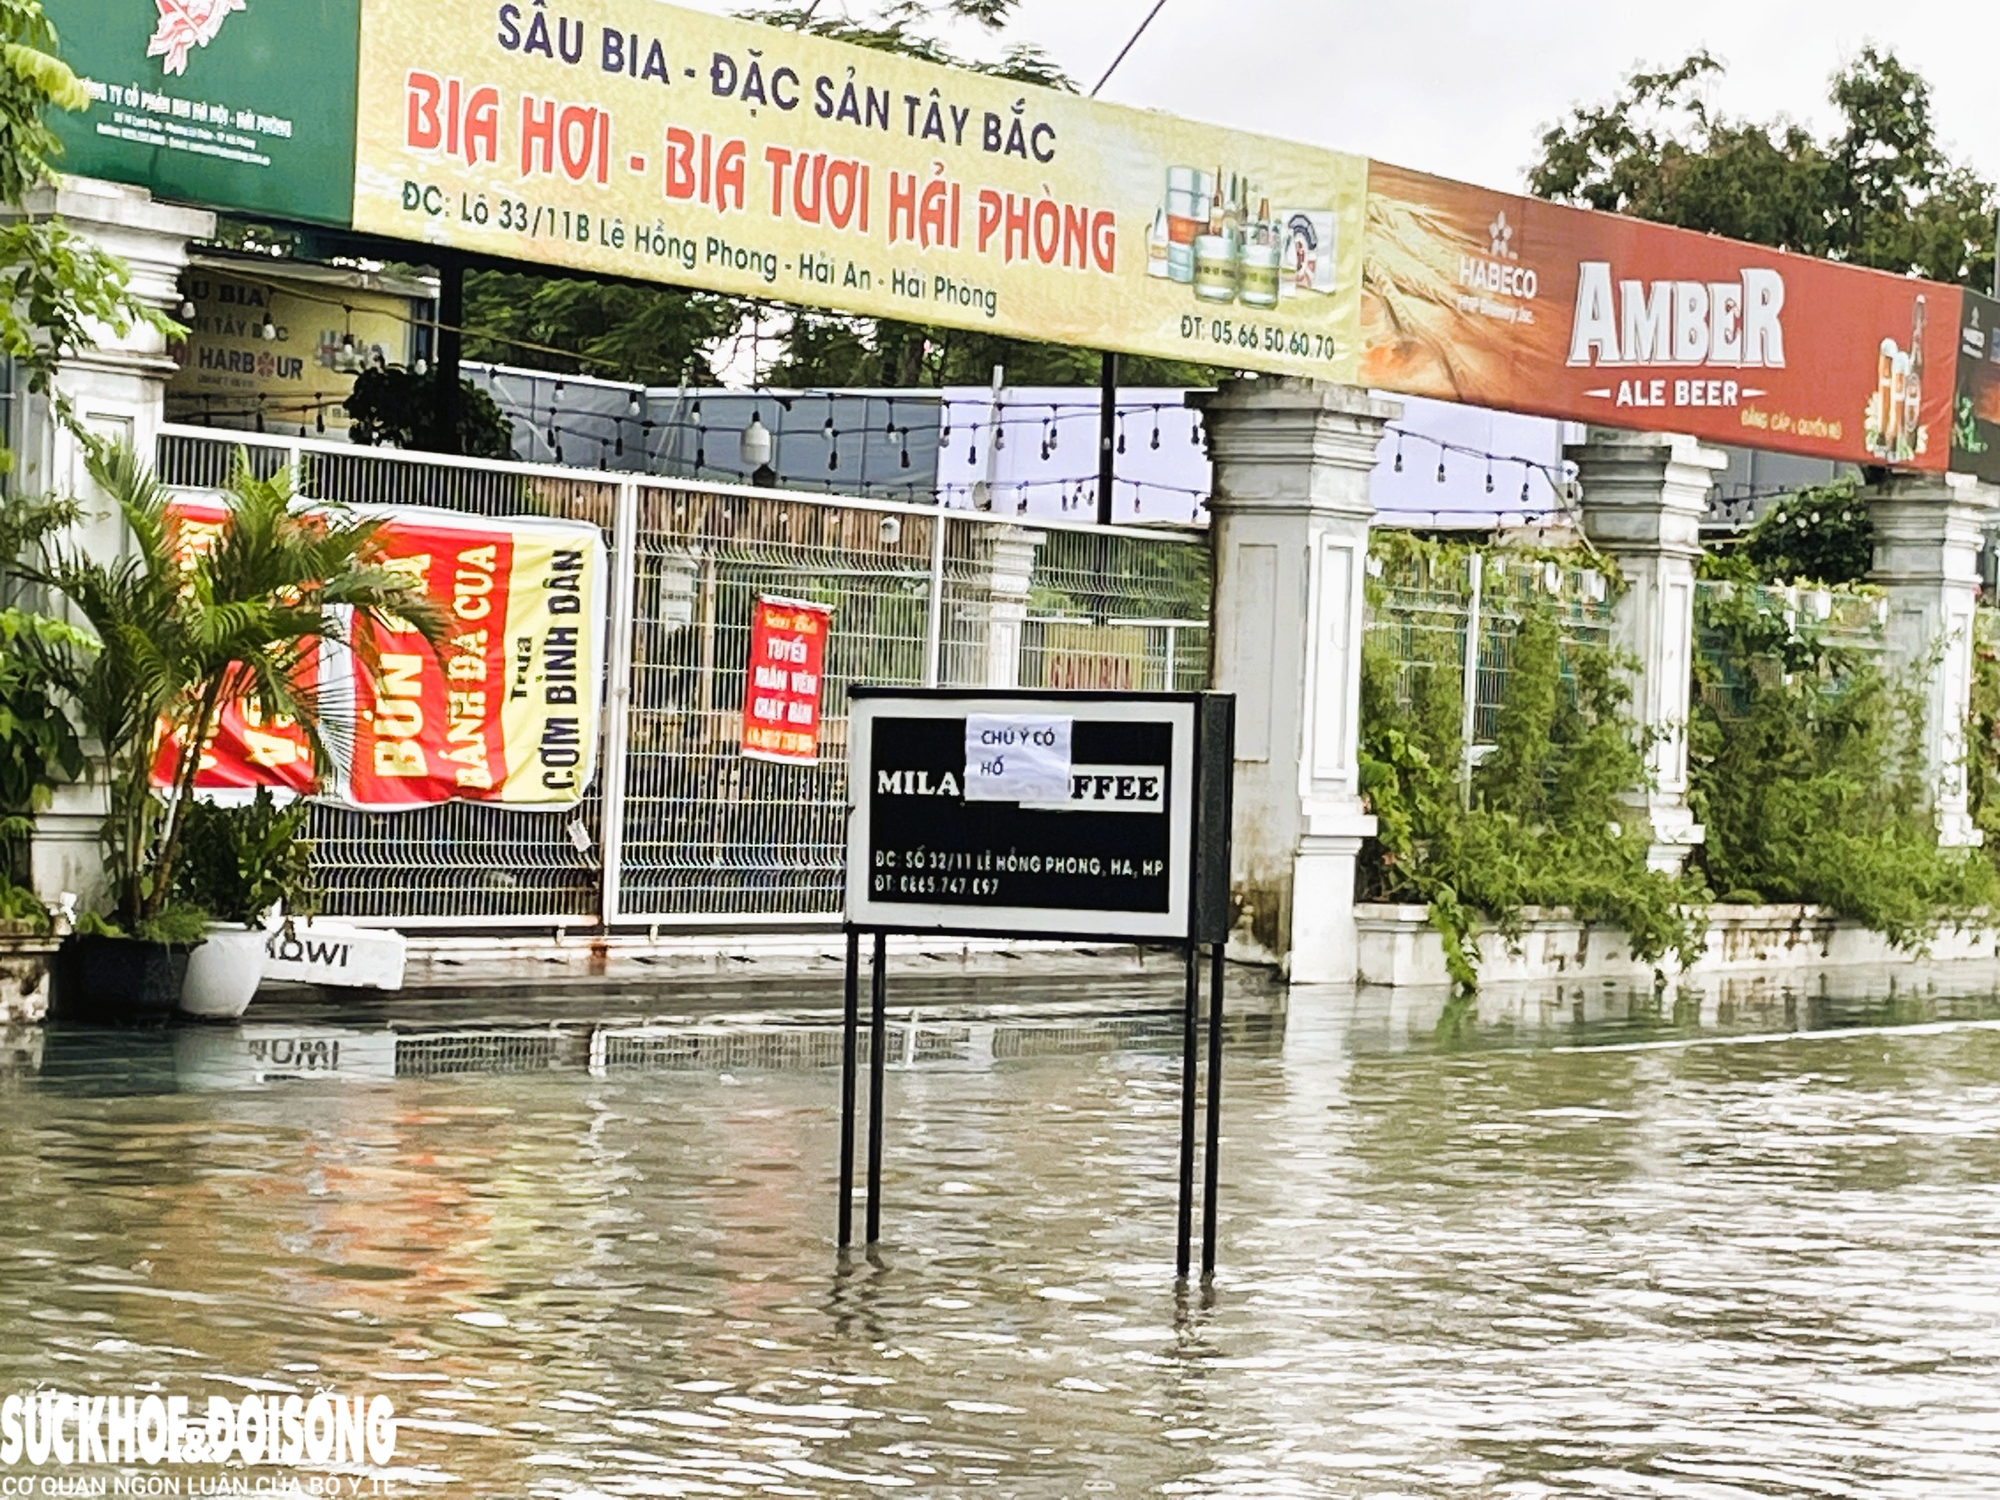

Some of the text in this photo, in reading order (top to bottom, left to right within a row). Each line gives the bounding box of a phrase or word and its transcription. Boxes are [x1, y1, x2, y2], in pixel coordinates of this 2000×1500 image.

[499, 0, 583, 64] SÂU
[602, 28, 670, 85] BIA
[711, 49, 800, 118] ĐẶC
[814, 66, 889, 131] SẢN
[904, 88, 970, 147] TÂY
[983, 98, 1057, 163] BẮC
[407, 72, 499, 168] BIA
[521, 96, 610, 184] HƠI
[666, 126, 747, 214] BIA
[764, 145, 870, 233] TƯƠI
[888, 161, 961, 251] HẢI
[979, 184, 1116, 275] PHÒNG
[402, 180, 450, 217] ĐC:
[461, 191, 489, 225] Lô
[499, 199, 589, 242] 33/11B
[600, 218, 625, 249] Lê
[706, 236, 777, 283] Phong
[799, 250, 836, 285] Hải
[842, 261, 871, 291] An
[934, 276, 998, 318] Phòng
[1458, 255, 1537, 300] HABECO
[252, 321, 289, 343] BC
[1181, 314, 1335, 361] ĐT: 05.66.50.60.70
[1566, 261, 1786, 369] AMBER
[1616, 379, 1739, 408] ALE BEER
[452, 545, 498, 620] CUA
[535, 549, 584, 790] CƠM BÌNH DÂN
[363, 653, 428, 777] BÚN
[438, 690, 493, 790] BÁNH
[981, 725, 1056, 747] CHÚ Ý CÓ
[877, 769, 1160, 802] MILA FFEE
[905, 845, 925, 869] SỐ
[929, 851, 971, 872] 32/11
[1045, 856, 1106, 877] PHONG,
[1143, 859, 1164, 877] HP
